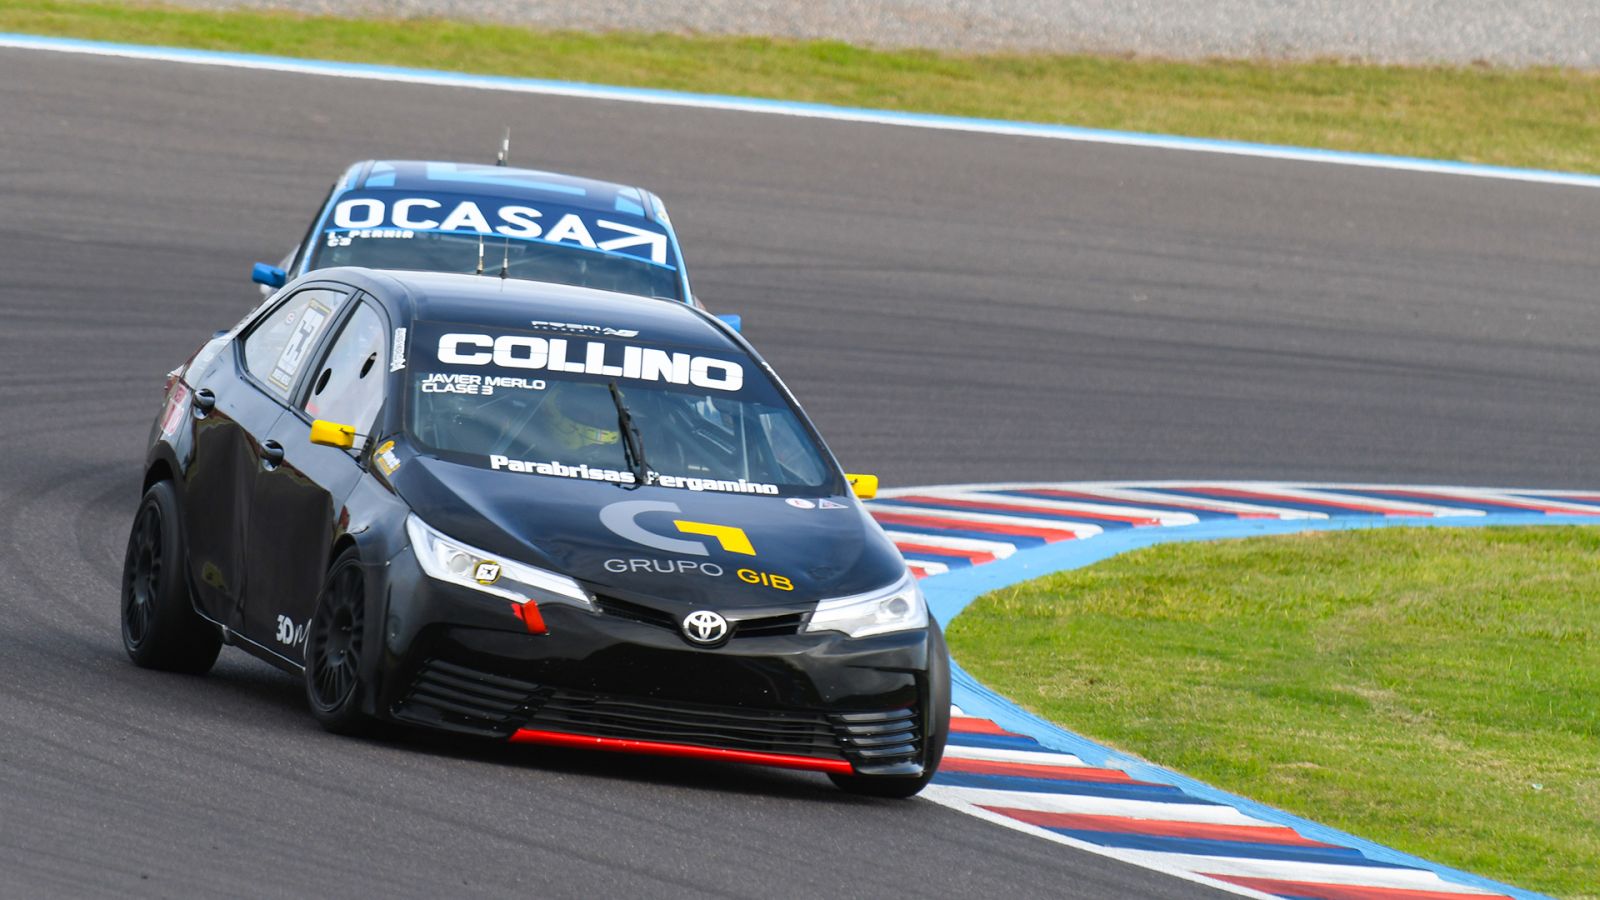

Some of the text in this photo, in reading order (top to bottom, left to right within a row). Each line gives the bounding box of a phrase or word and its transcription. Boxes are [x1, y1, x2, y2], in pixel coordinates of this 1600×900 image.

[334, 199, 597, 249] OCASA
[437, 333, 744, 392] COLLINO
[422, 373, 546, 390] JAVIER MERLO
[422, 383, 494, 396] CLASE 3
[489, 454, 636, 484] Parabrisas
[604, 558, 795, 592] GRUPO GIB
